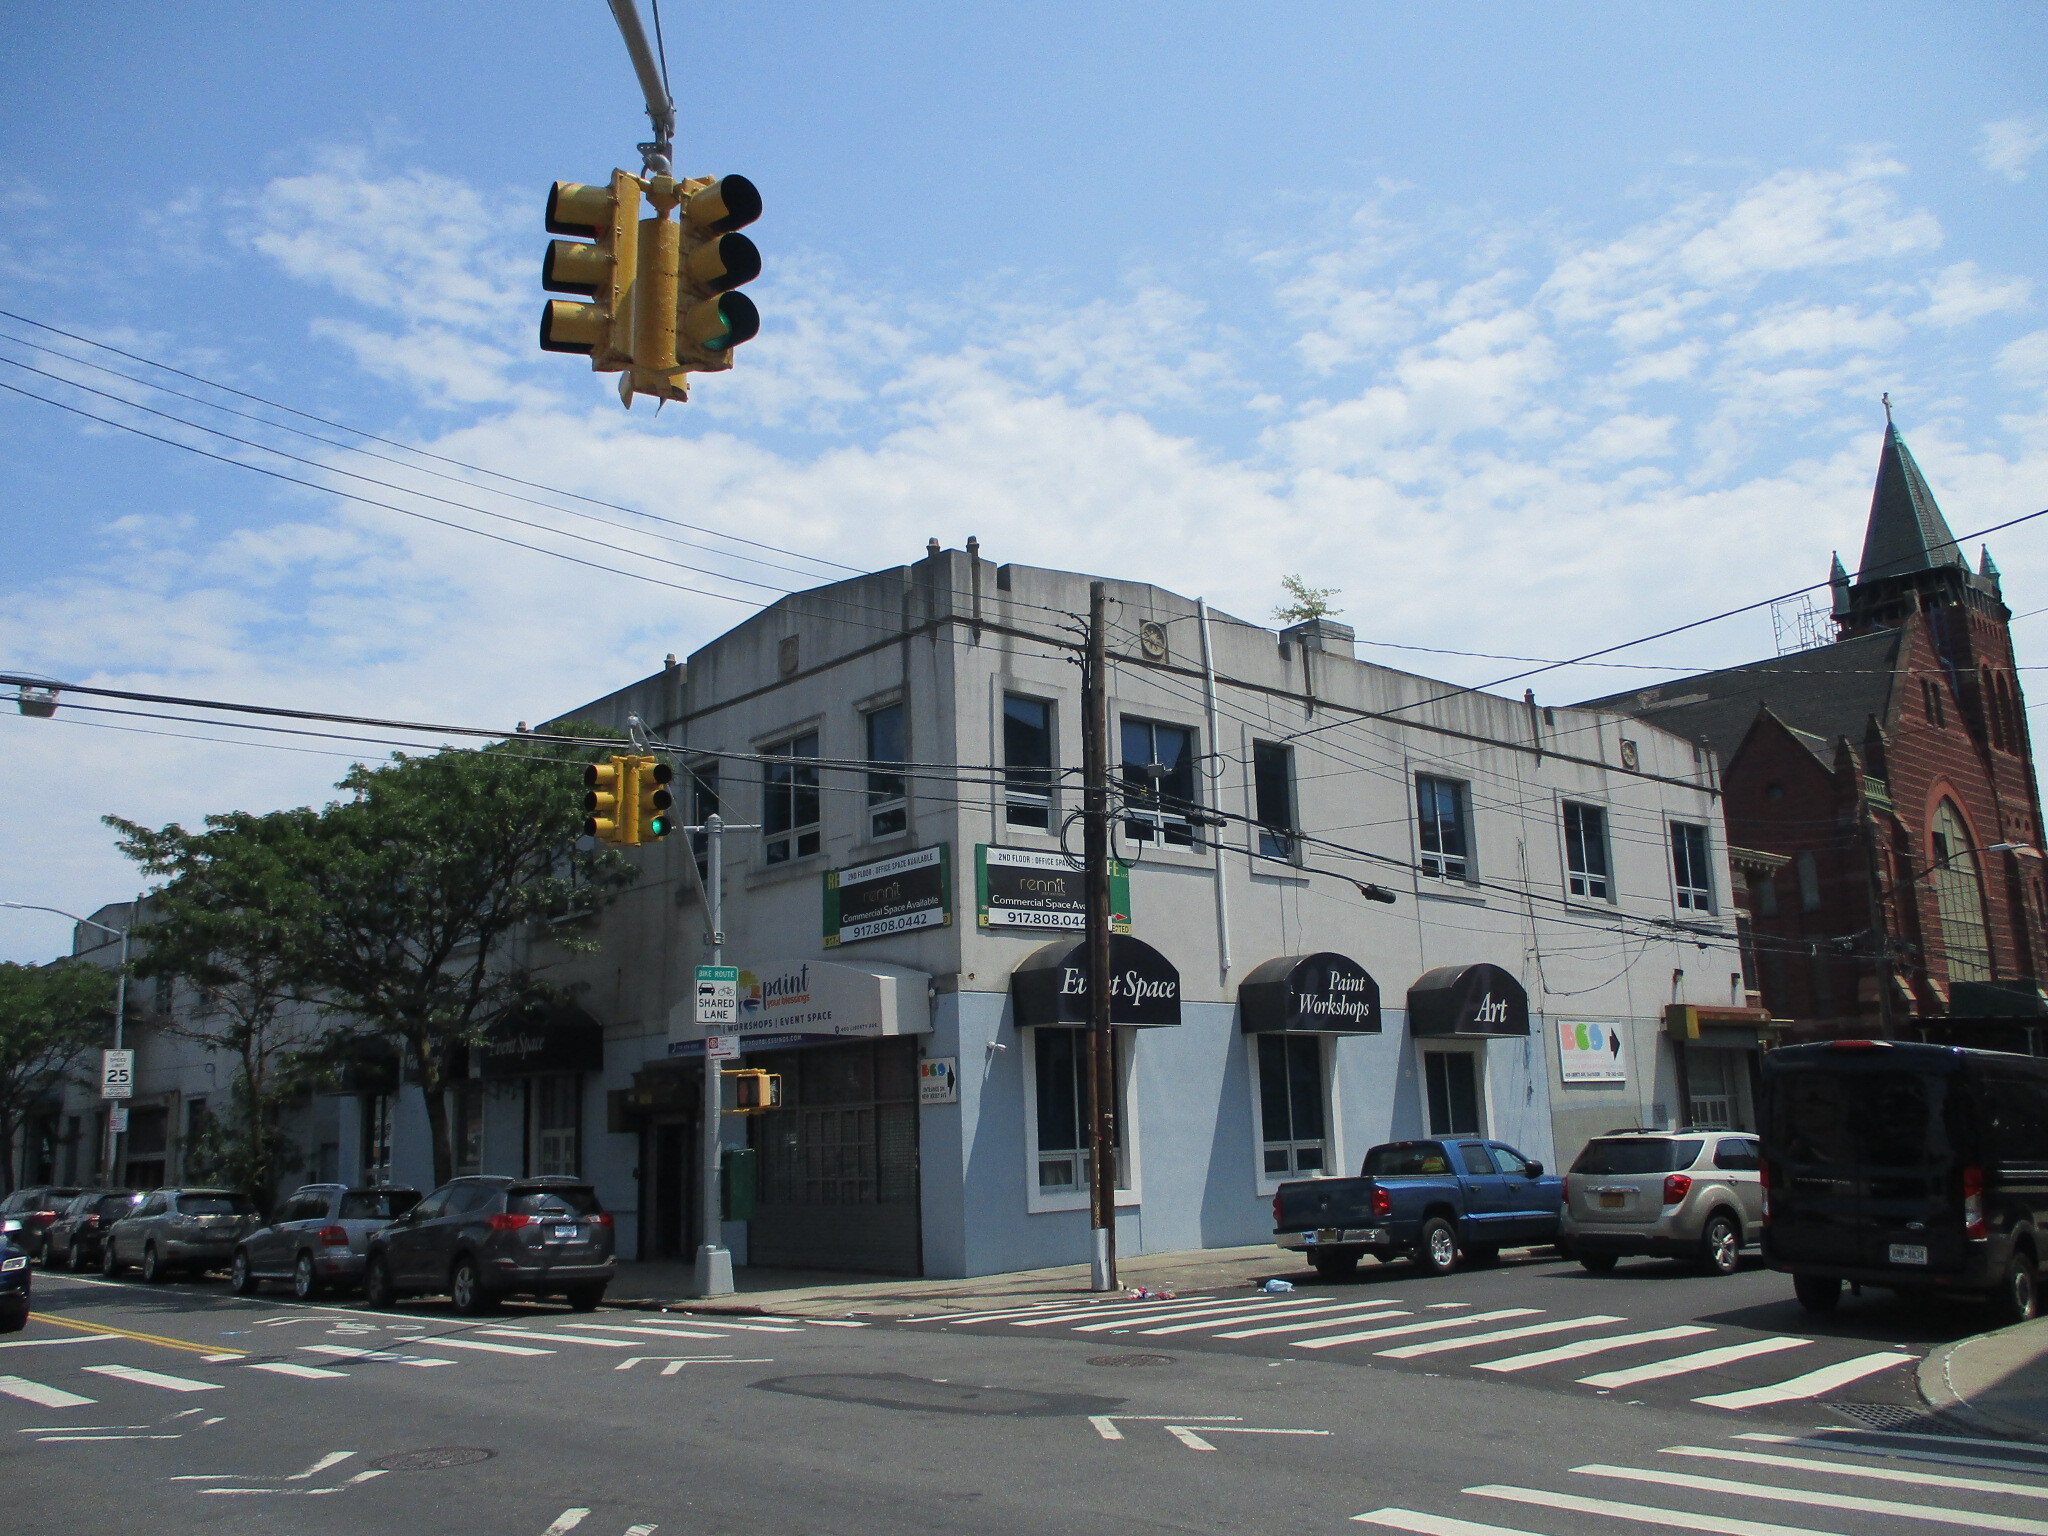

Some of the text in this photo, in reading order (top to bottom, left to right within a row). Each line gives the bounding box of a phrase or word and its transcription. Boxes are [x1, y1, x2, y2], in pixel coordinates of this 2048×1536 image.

[847, 873, 857, 881] 2ND
[857, 869, 873, 879] FLOOR
[875, 865, 891, 875] OFFICE
[891, 860, 907, 871] SPACE
[907, 853, 933, 866] AVAILABLE
[998, 853, 1011, 862] 2ND
[1011, 854, 1031, 864] FLOOR
[1034, 856, 1055, 866] OFFICE
[1055, 858, 1072, 868] SPA
[863, 881, 901, 902] rennit
[1019, 877, 1066, 893] rennit
[842, 896, 939, 924] Commercial Space Available
[992, 894, 1044, 907] Commercial
[1045, 899, 1071, 910] Space
[853, 913, 927, 938] 917.808.0442
[1007, 911, 1086, 927] 917.808.044
[698, 969, 735, 978] BIKE ROUTE
[1328, 970, 1366, 992] Paint
[763, 963, 810, 1011] paint
[1059, 967, 1176, 1006] Evt Space
[698, 998, 735, 1008] SHARED
[1299, 993, 1370, 1023] Workshops
[1473, 991, 1508, 1023] Art
[704, 1010, 729, 1019] LANE
[727, 1010, 832, 1033] WORKSHOPS EVENT SPACE
[107, 1069, 129, 1083] 25
